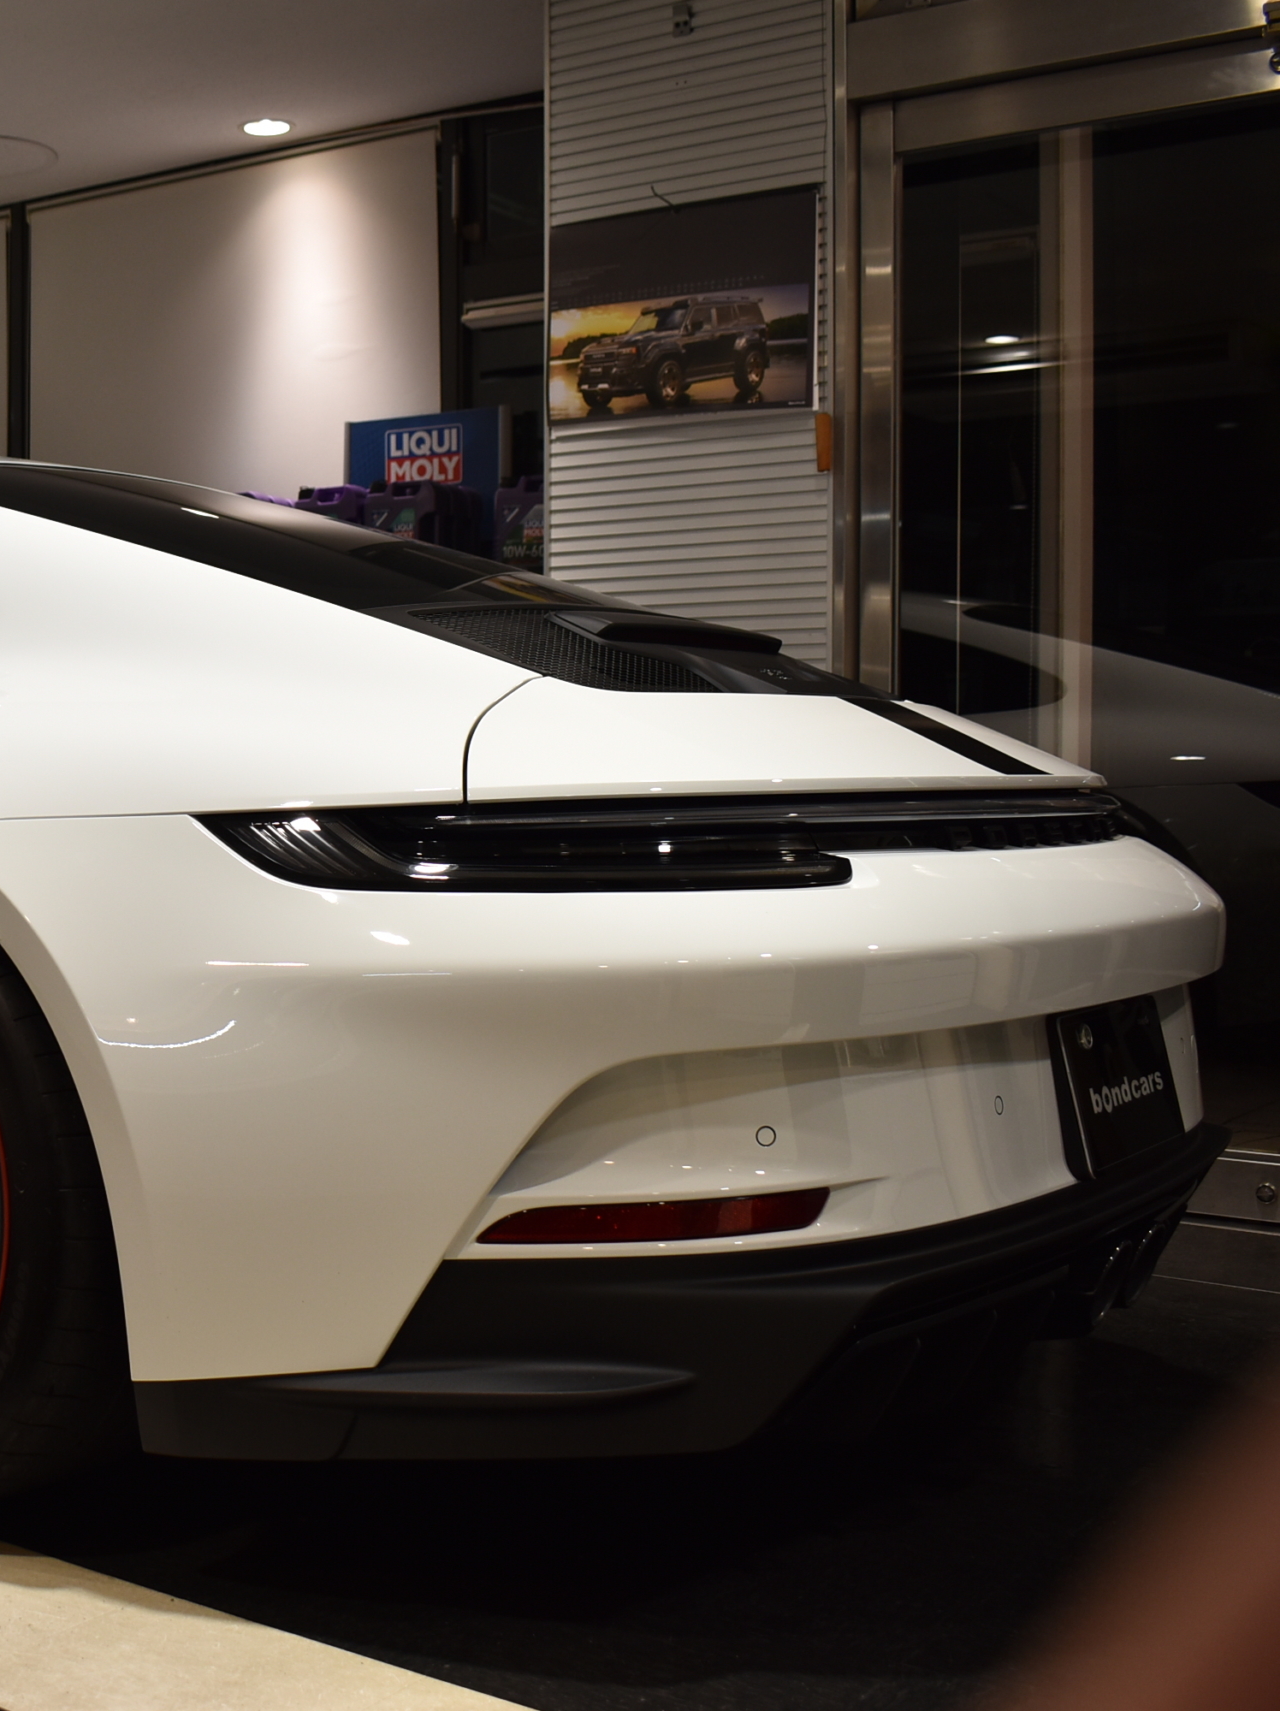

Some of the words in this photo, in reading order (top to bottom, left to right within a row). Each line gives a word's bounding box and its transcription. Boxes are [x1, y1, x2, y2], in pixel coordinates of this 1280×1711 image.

[389, 427, 458, 458] LIQUI
[389, 455, 460, 483] MOLY
[1089, 1071, 1164, 1114] bondcars
